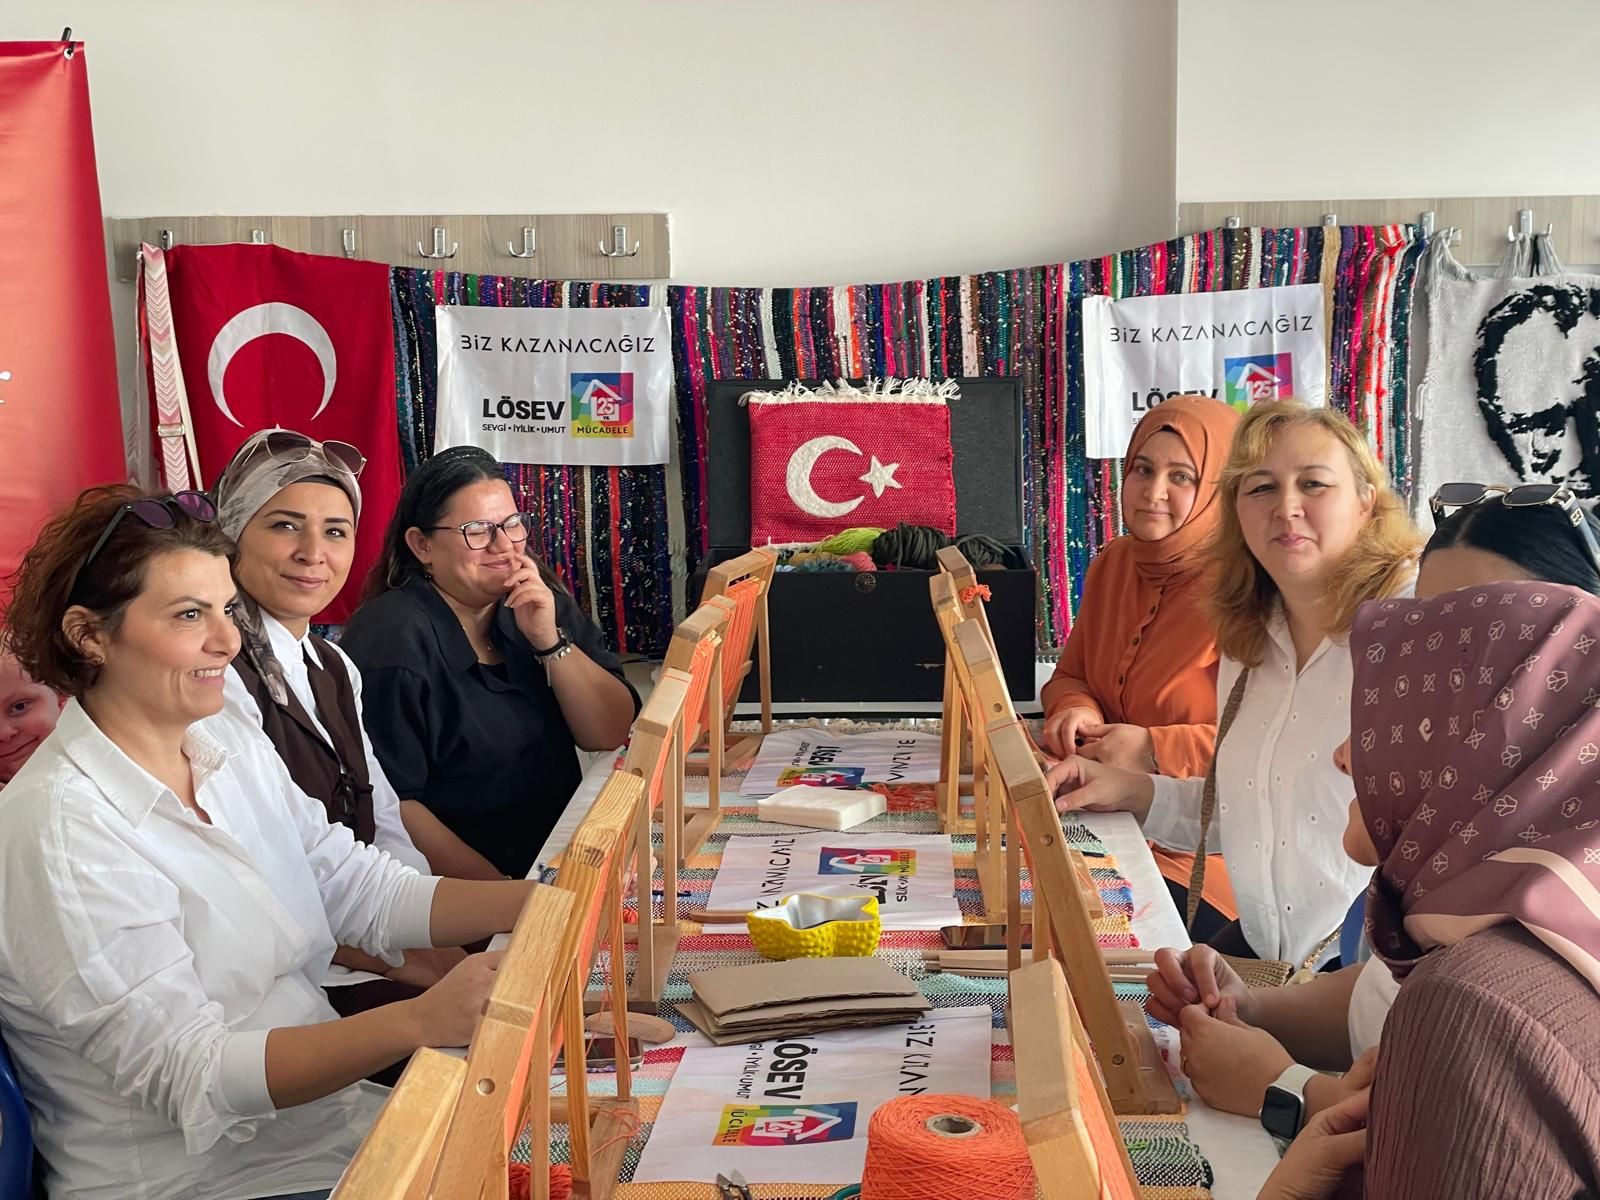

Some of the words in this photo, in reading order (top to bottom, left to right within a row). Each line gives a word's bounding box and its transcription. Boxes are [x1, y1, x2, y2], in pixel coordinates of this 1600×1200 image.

[483, 395, 566, 421] LÖSEV
[597, 397, 615, 415] 25
[541, 426, 566, 434] UMUT
[577, 425, 628, 434] MÜCADELE
